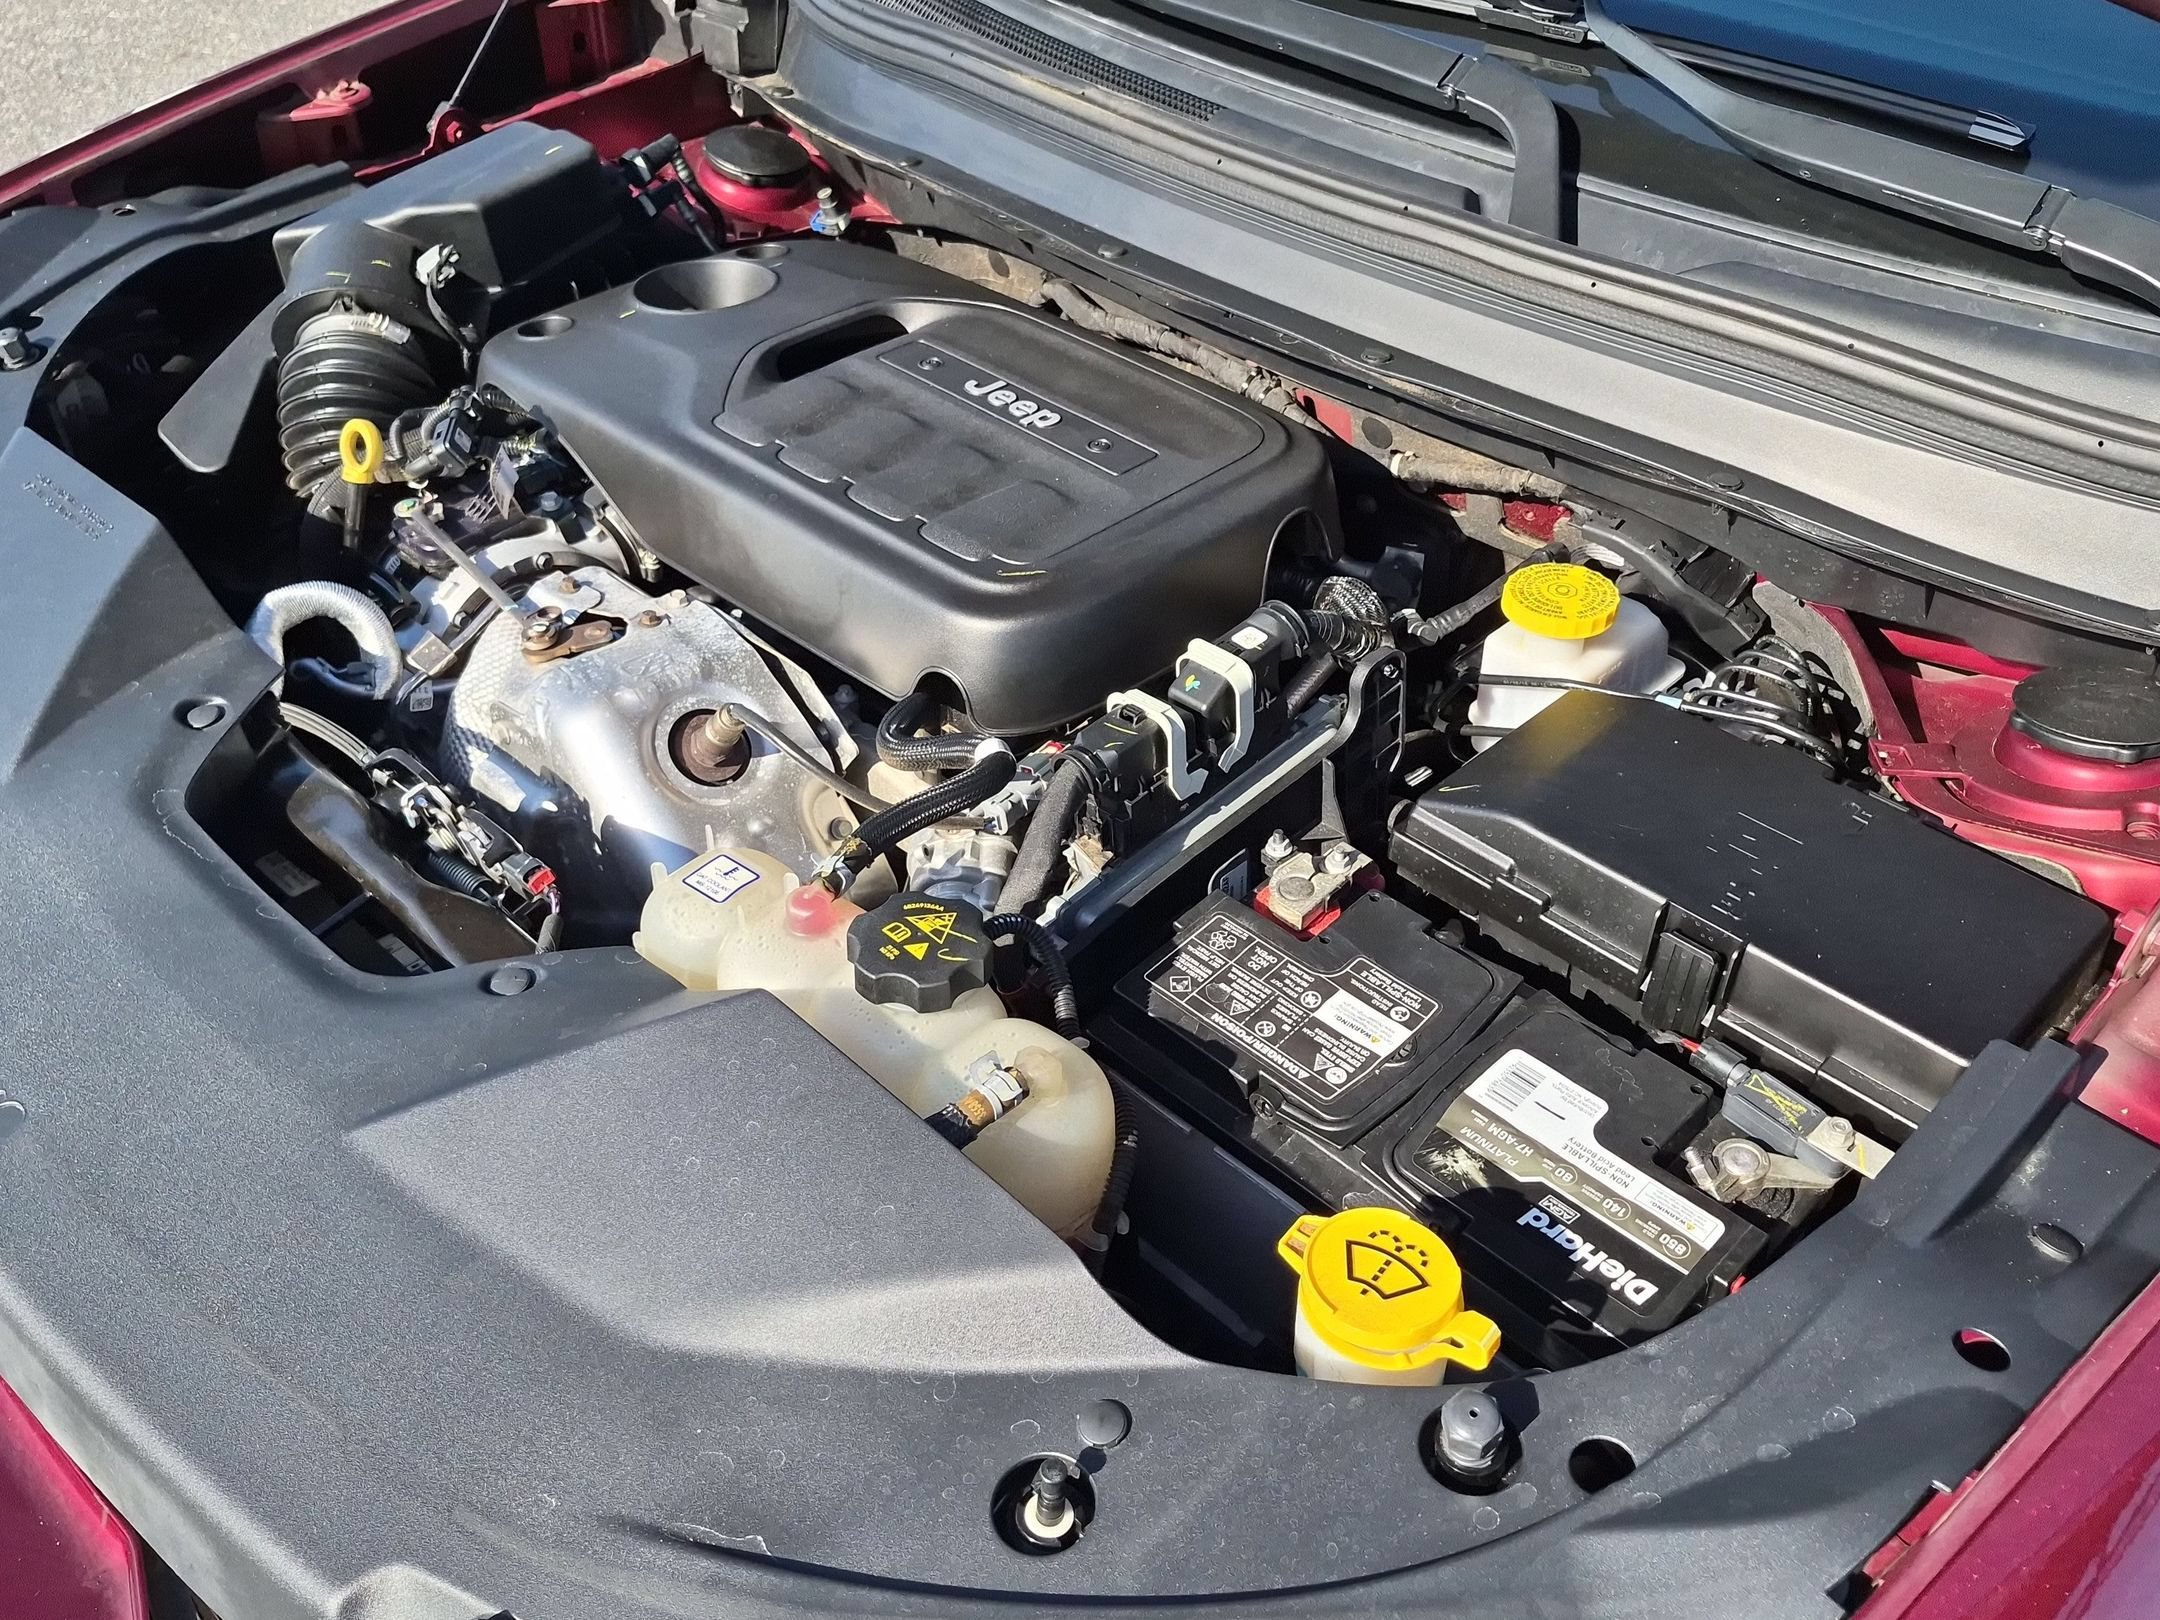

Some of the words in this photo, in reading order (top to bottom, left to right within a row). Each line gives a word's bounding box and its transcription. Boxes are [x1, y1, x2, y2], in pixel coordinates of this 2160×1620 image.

[964, 379, 1063, 428] Jeep
[1251, 954, 1269, 967] NOT
[1255, 946, 1277, 963] OPEN.
[1247, 961, 1261, 971] DO
[1228, 972, 1237, 980] OR
[1270, 979, 1283, 987] OUT
[1284, 978, 1295, 987] THE
[1289, 974, 1309, 987] REACH
[1369, 968, 1395, 984] Battery
[1231, 982, 1249, 995] CAUSE
[1236, 978, 1266, 999] BLINDNESS
[1249, 979, 1272, 994] SEVERE
[1282, 987, 1298, 998] KEEP
[1351, 978, 1393, 1007] INSTRUCTIONS.
[1358, 971, 1420, 1009] NON-SPILLABLE
[1391, 983, 1406, 992] Acid
[1248, 994, 1261, 1003] CAN
[1405, 991, 1422, 1002] Lead
[1275, 1004, 1298, 1019] FLAMES
[1371, 999, 1389, 1011] READ
[1271, 1008, 1293, 1024] SPARKS
[1302, 1027, 1315, 1037] CAN
[1314, 1028, 1346, 1050] BLINDNESS
[1211, 1013, 1299, 1073] DANGER/POISON
[1345, 1048, 1366, 1062] CAUSE
[1461, 1127, 1518, 1166] PLATINUM
[1488, 1123, 1533, 1156] H7-AGM
[1568, 1137, 1597, 1158] Battery
[1562, 1144, 1629, 1188] NON-SPILLABLE
[1597, 1156, 1615, 1168] Acid
[1555, 1168, 1573, 1182] 80
[1615, 1167, 1635, 1182] Lead
[1542, 1198, 1573, 1219] AGM
[1602, 1199, 1625, 1217] 140
[1659, 1234, 1686, 1255] 850
[1516, 1207, 1659, 1306] DieHard
